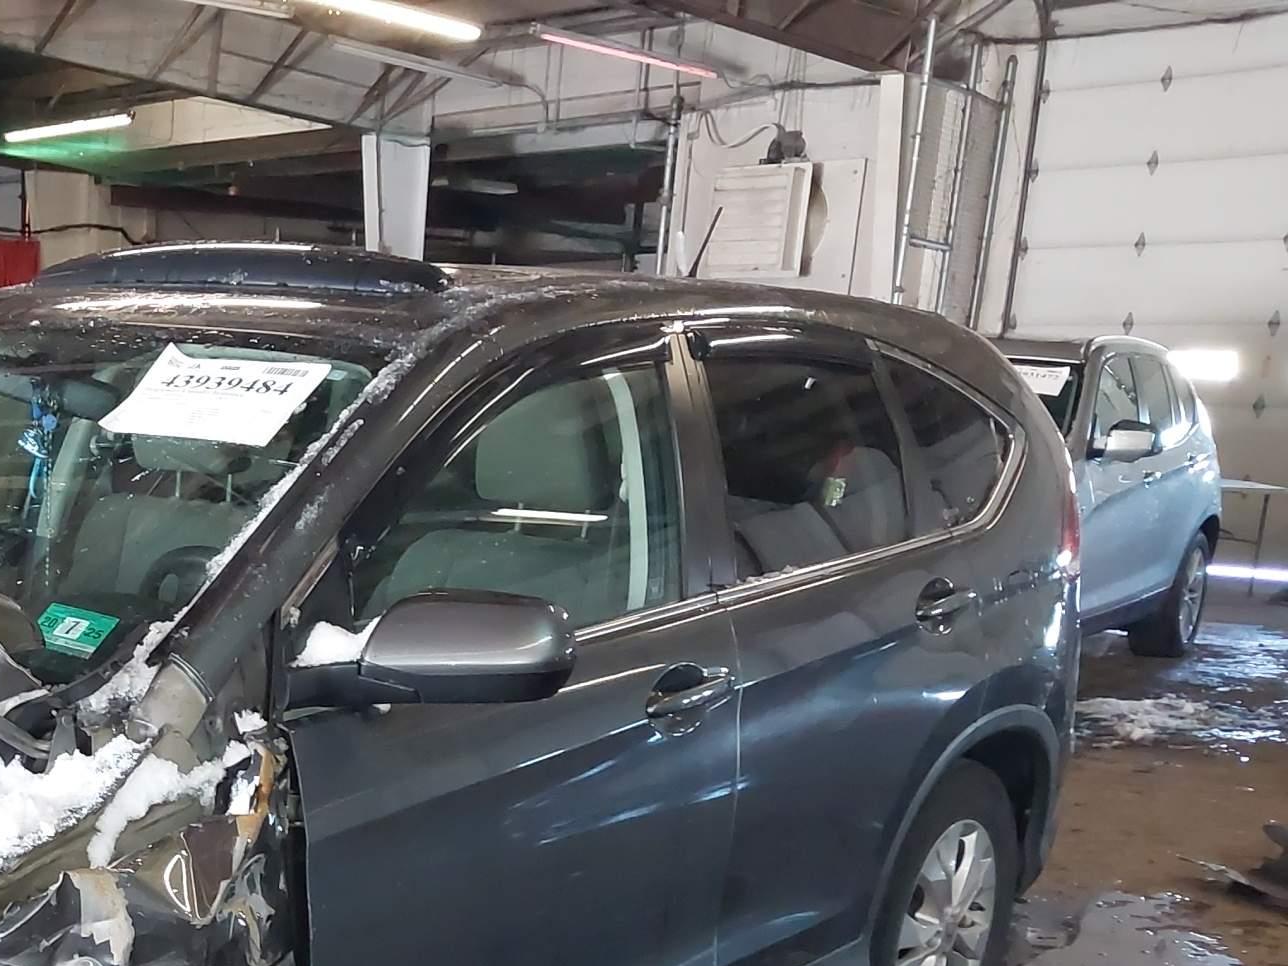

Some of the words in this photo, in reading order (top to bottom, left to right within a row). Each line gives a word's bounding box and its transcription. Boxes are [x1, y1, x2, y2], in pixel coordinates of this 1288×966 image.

[160, 373, 295, 396] 43939484
[40, 615, 59, 629] 20
[64, 620, 81, 635] 7
[83, 627, 105, 640] 25
